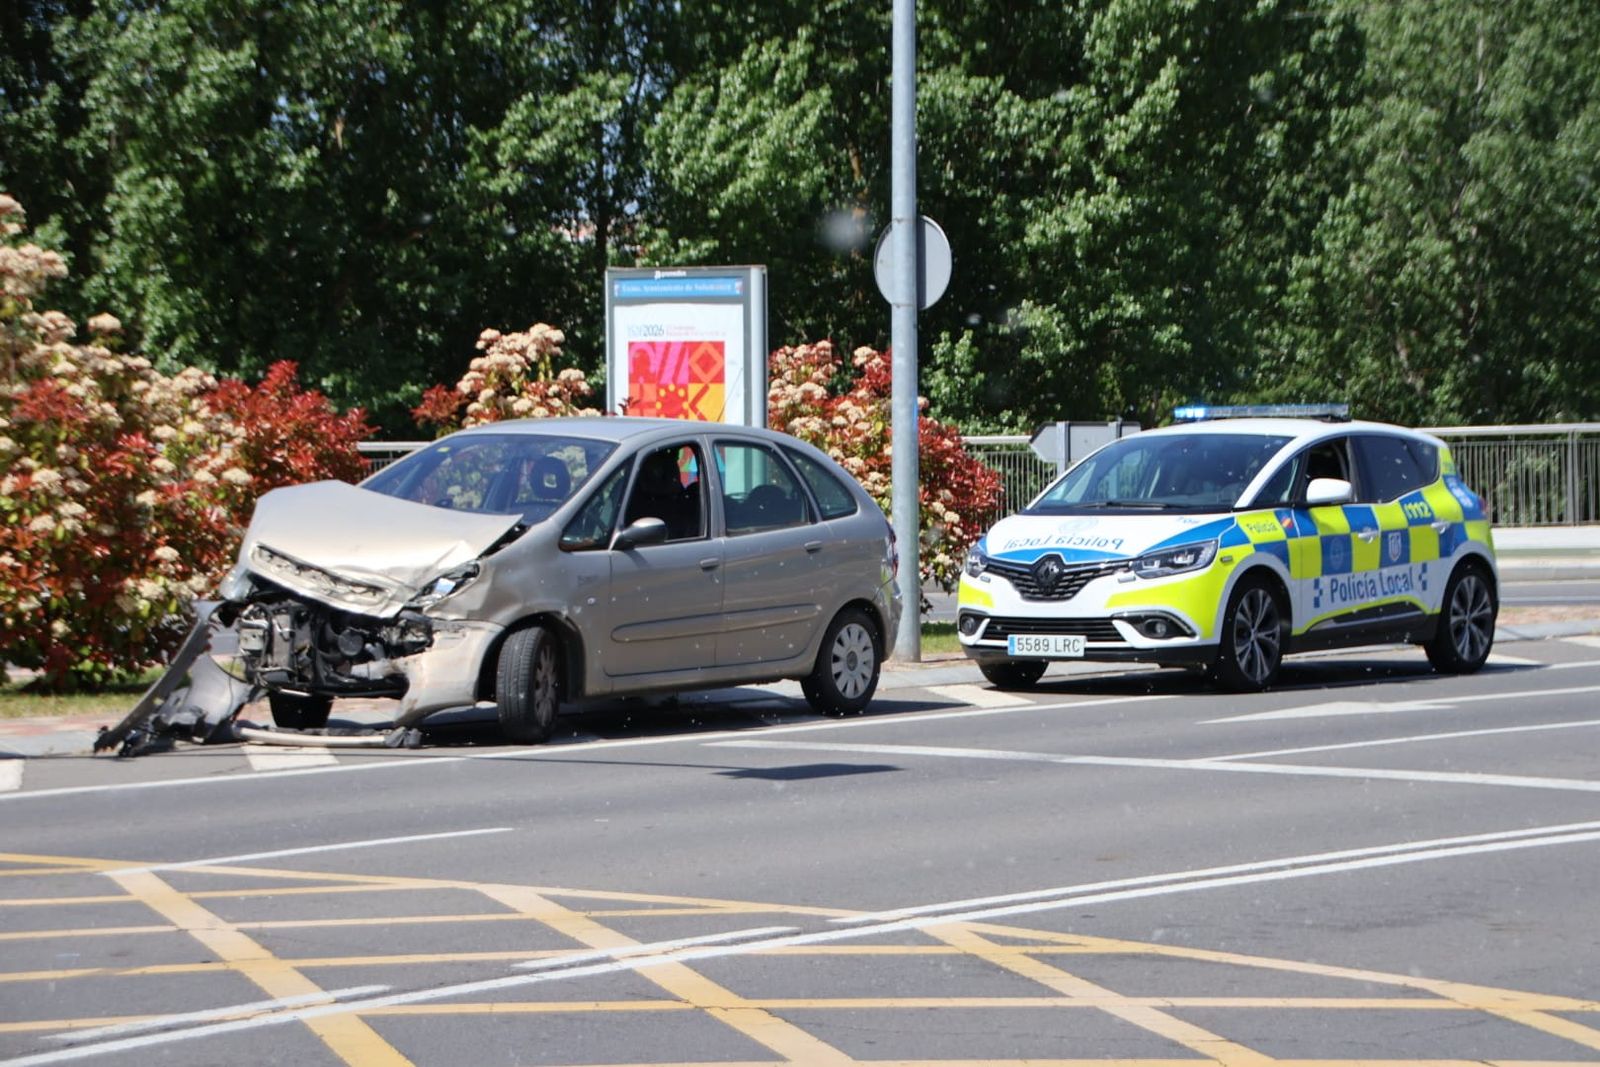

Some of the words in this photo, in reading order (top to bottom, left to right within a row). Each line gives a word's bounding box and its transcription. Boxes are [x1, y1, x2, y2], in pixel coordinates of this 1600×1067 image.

[1329, 571, 1378, 603] Policía
[1379, 566, 1414, 596] Local
[1017, 637, 1050, 652] 5589
[1054, 638, 1080, 653] LRC
